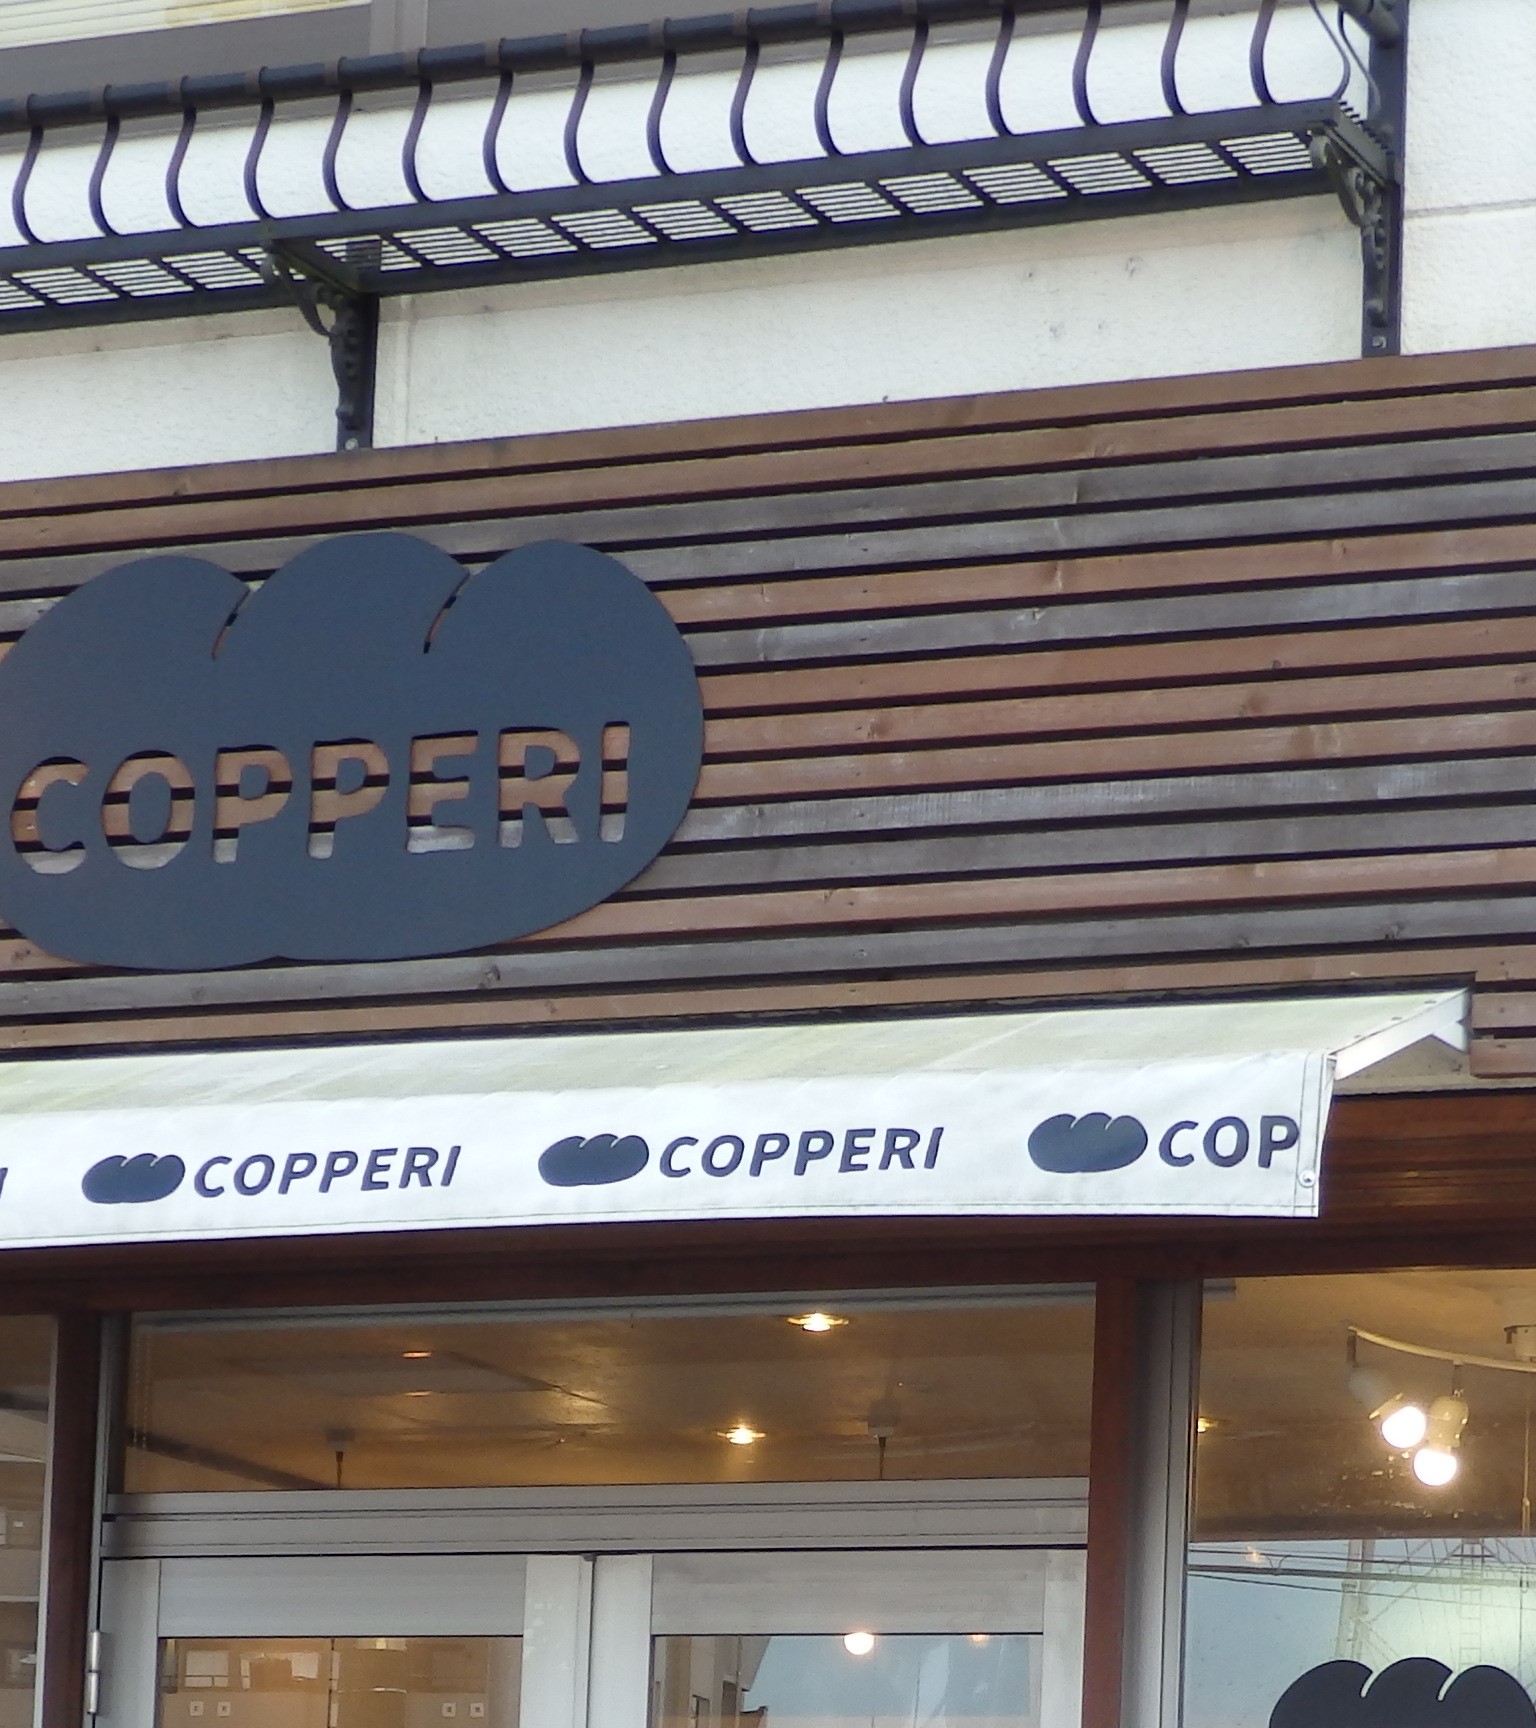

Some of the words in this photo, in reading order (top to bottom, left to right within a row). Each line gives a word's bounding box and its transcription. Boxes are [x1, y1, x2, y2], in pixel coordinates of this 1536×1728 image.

[11, 720, 631, 875] COPPERI
[659, 1126, 945, 1178] COPPERI
[1158, 1114, 1300, 1169] COP
[193, 1144, 462, 1198] COPPERI
